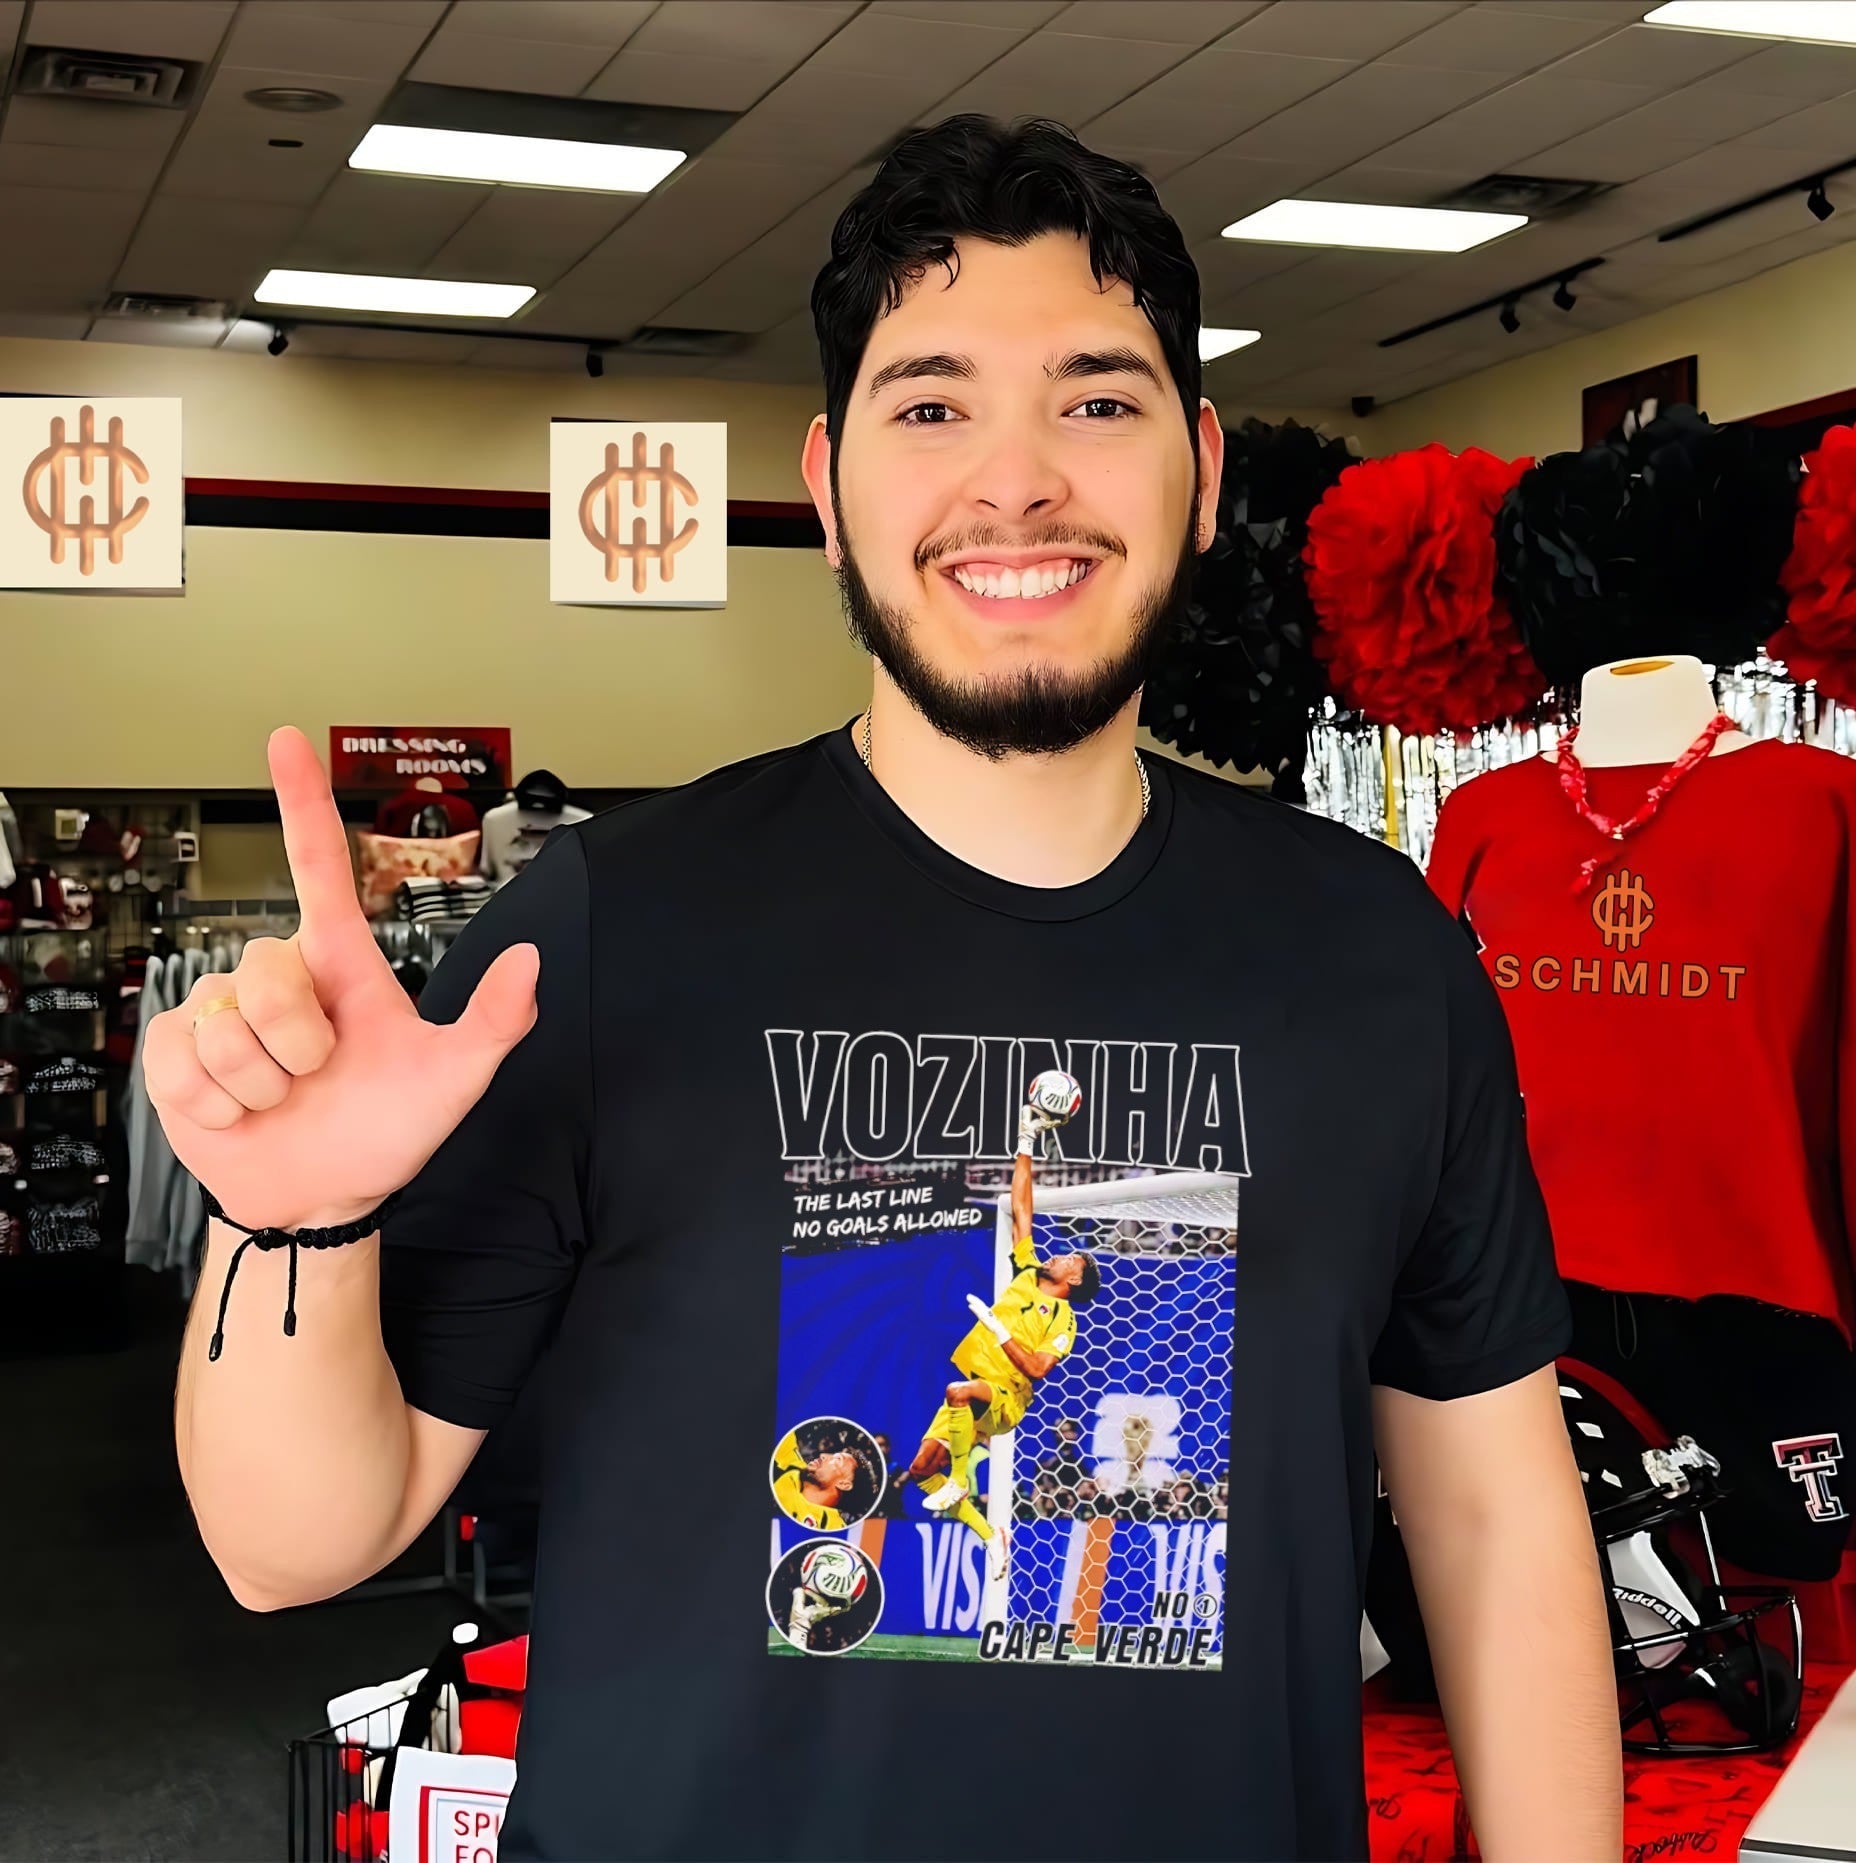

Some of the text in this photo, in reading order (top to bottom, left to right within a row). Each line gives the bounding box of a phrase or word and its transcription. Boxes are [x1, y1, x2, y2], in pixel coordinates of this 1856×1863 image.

[396, 758, 488, 776] ROOMS
[1493, 953, 1747, 1000] SCHMIDT
[764, 1028, 1252, 1177] VOZINHA
[793, 1186, 934, 1214] THE LAST LINE
[792, 1208, 983, 1239] NO GOALS ALLOWED
[915, 1522, 984, 1632] VIS
[1152, 1591, 1189, 1619] NO
[978, 1619, 1214, 1669] CAPE VERDE
